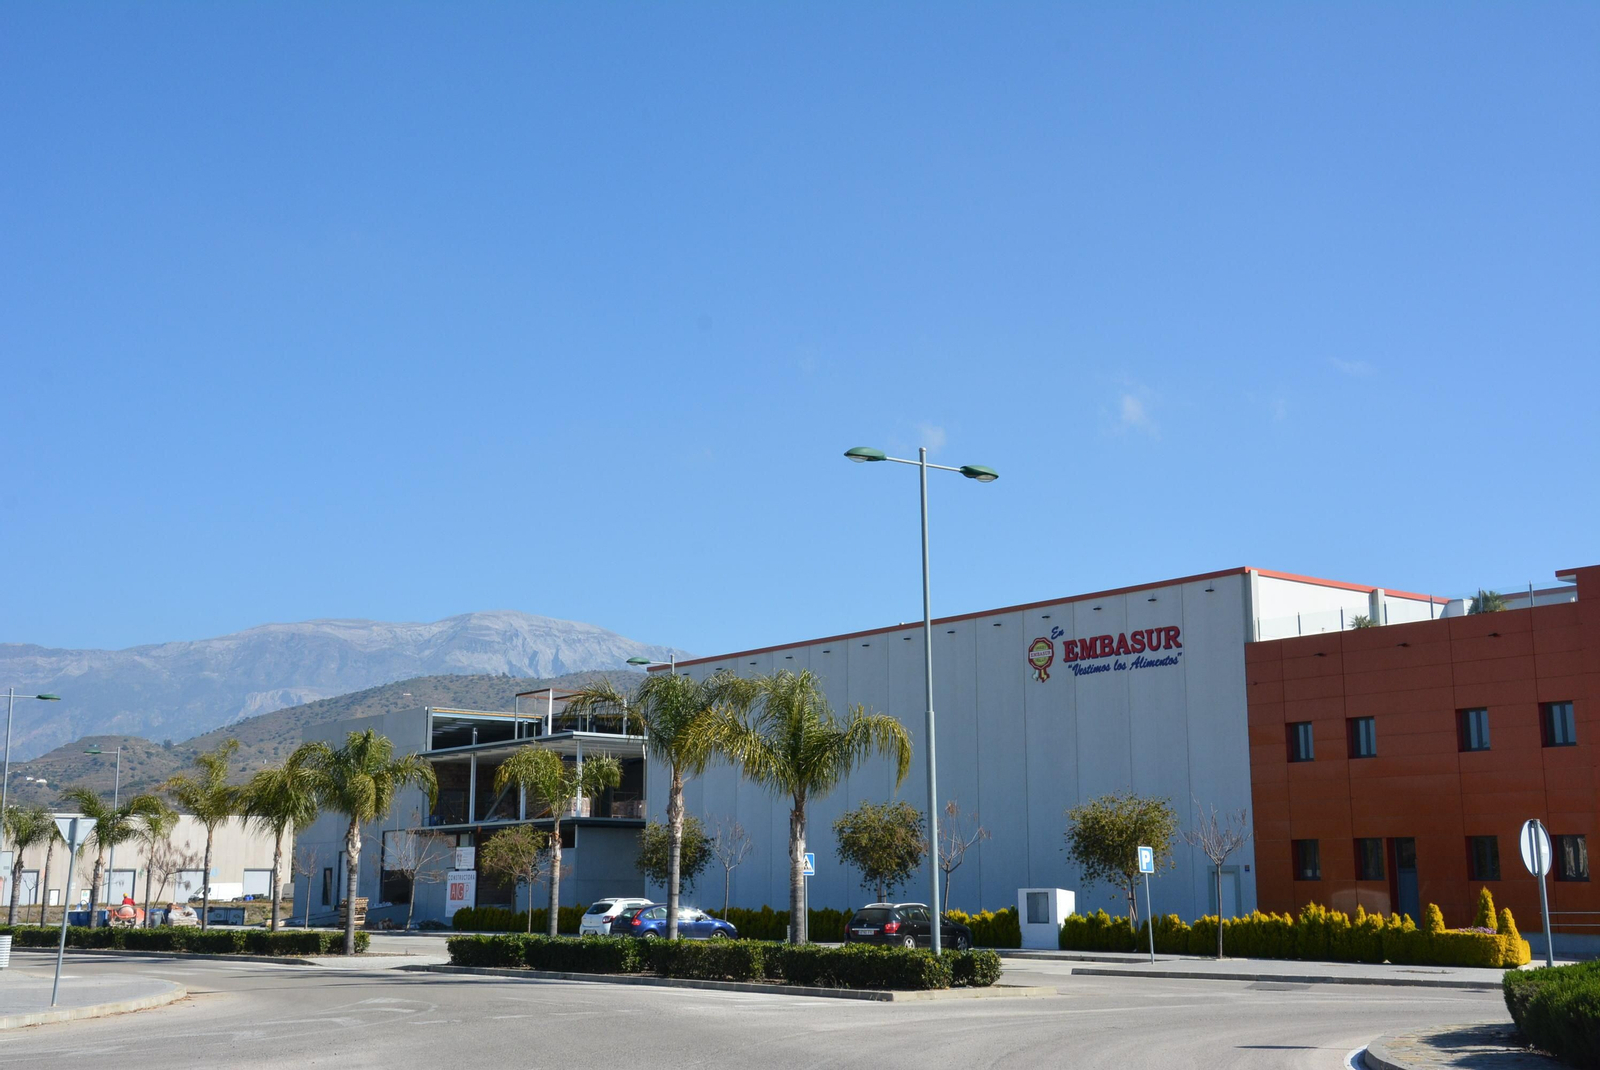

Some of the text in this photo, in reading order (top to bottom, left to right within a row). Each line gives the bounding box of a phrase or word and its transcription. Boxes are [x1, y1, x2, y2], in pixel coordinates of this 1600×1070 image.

[1051, 626, 1065, 640] En
[1063, 626, 1183, 663] EMBASUR
[1031, 650, 1051, 658] EMBASUR
[1113, 659, 1126, 671] los
[1141, 850, 1151, 870] P
